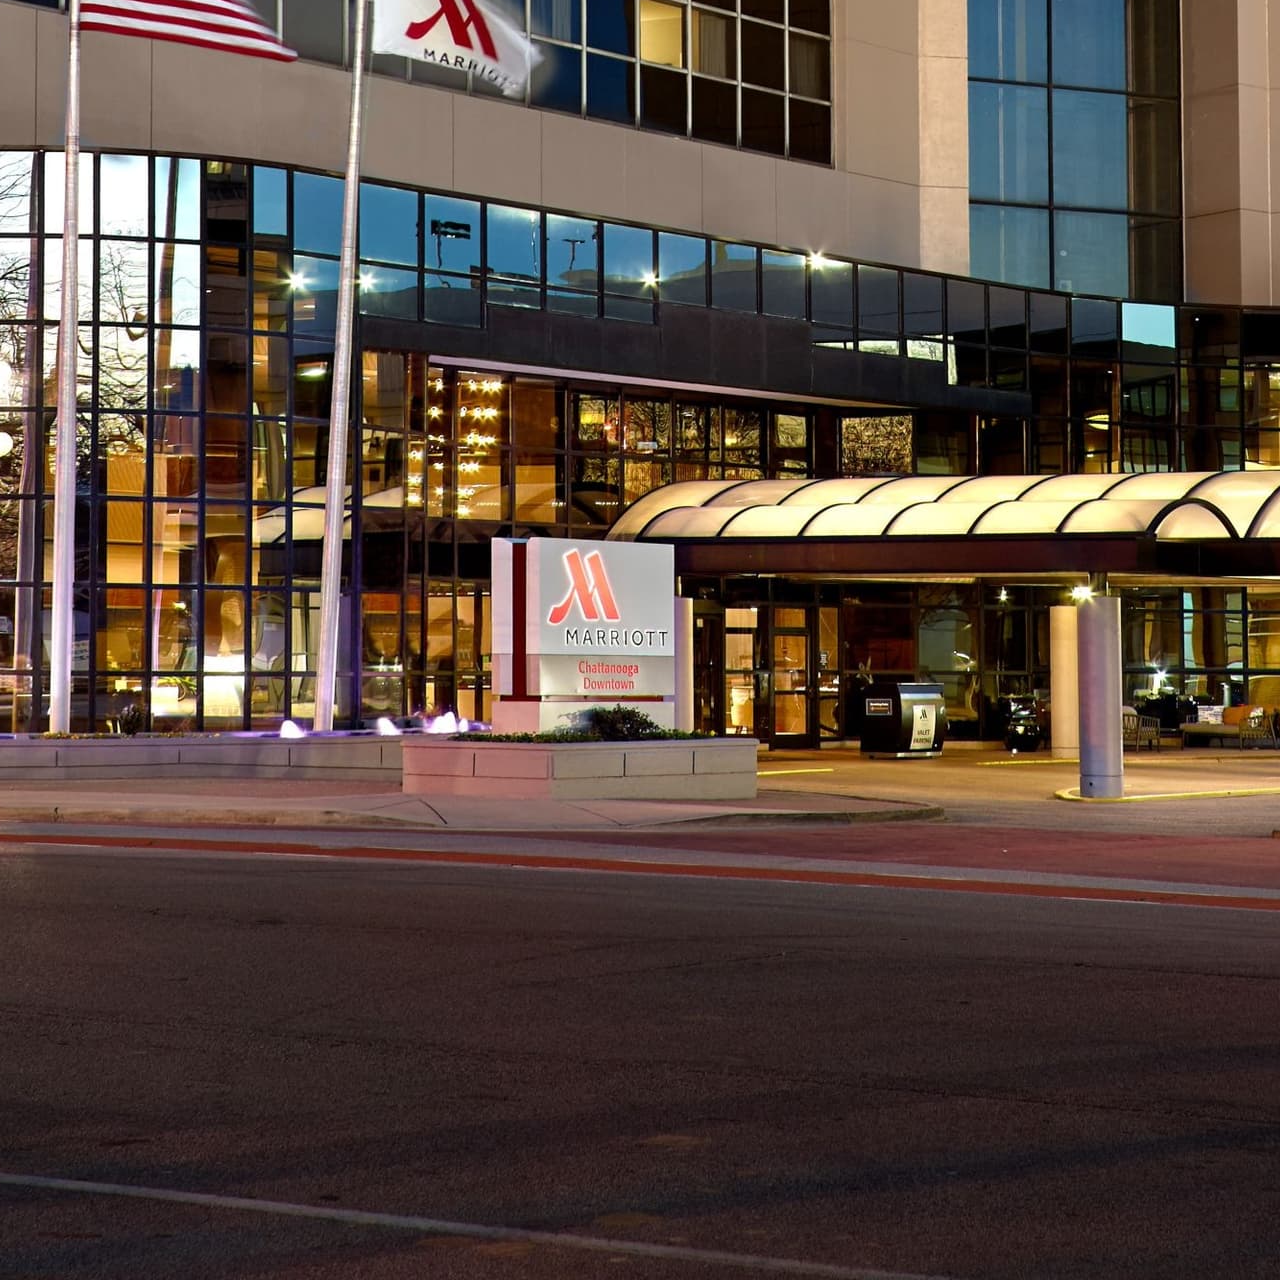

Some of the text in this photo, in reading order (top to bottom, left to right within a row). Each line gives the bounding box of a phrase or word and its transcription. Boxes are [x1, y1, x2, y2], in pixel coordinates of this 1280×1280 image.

[565, 628, 668, 647] MARRIOTT
[578, 660, 639, 677] Chattanooga
[583, 677, 635, 690] Downtown
